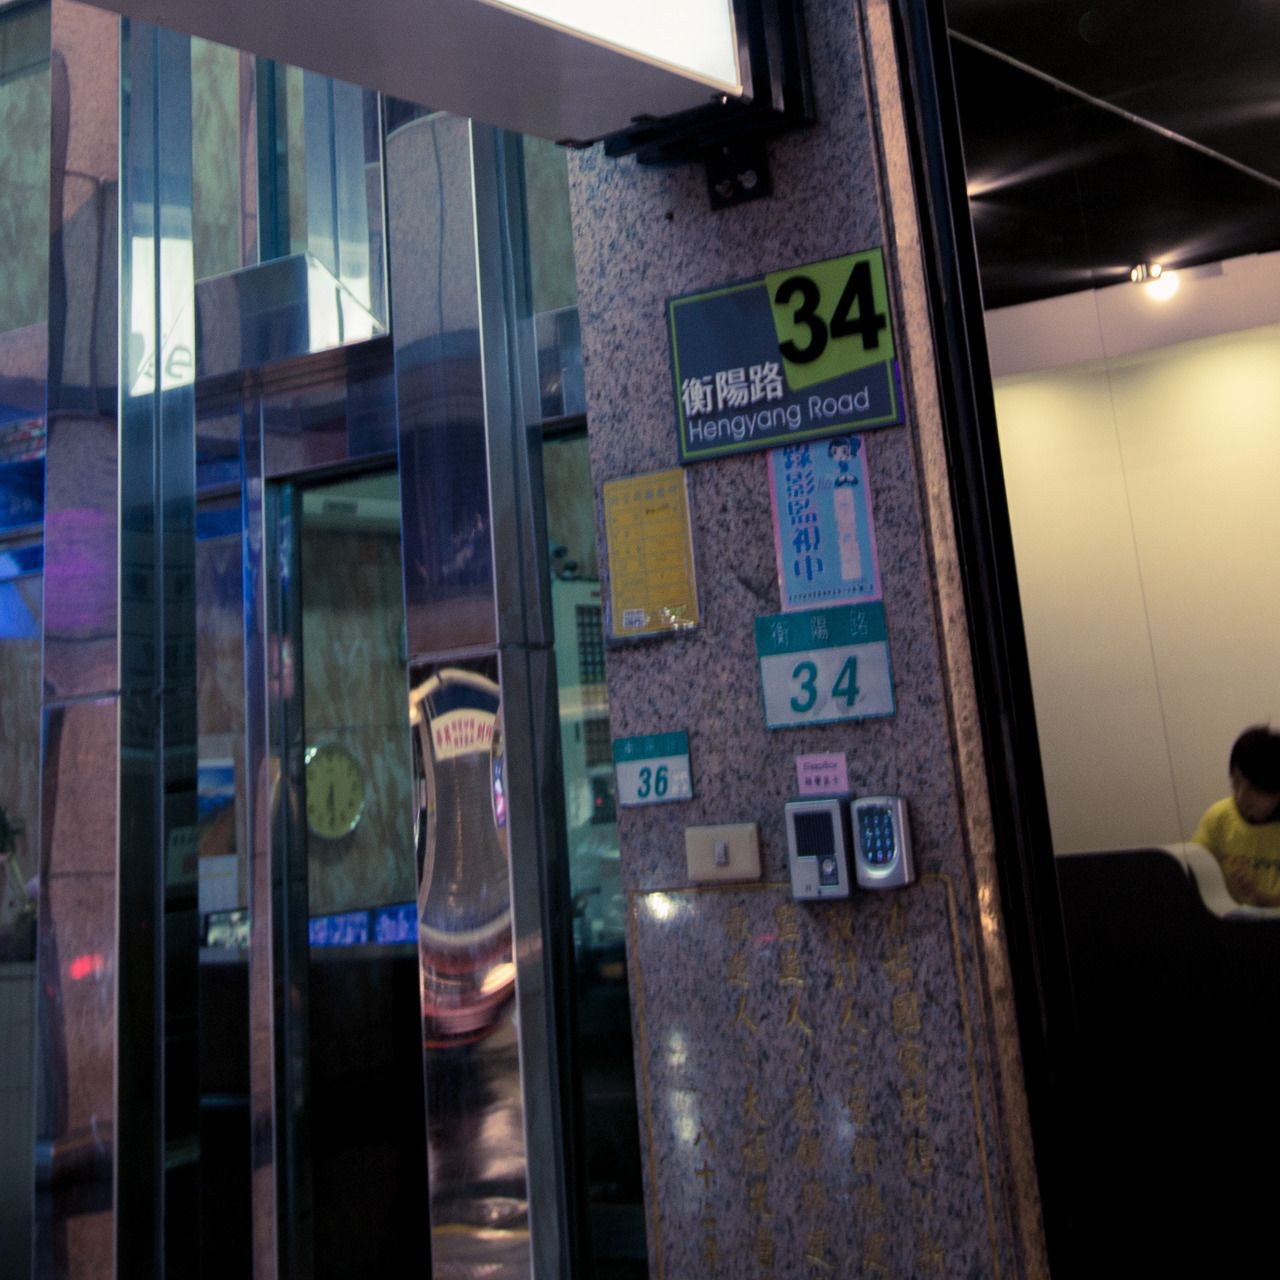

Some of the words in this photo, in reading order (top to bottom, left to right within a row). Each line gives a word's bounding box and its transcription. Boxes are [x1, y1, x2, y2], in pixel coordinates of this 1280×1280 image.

[774, 260, 887, 365] 34
[681, 361, 785, 418] 衡陽路
[688, 404, 801, 443] Hengyang
[808, 387, 871, 419] Road
[789, 654, 861, 713] 34
[637, 766, 669, 798] 36
